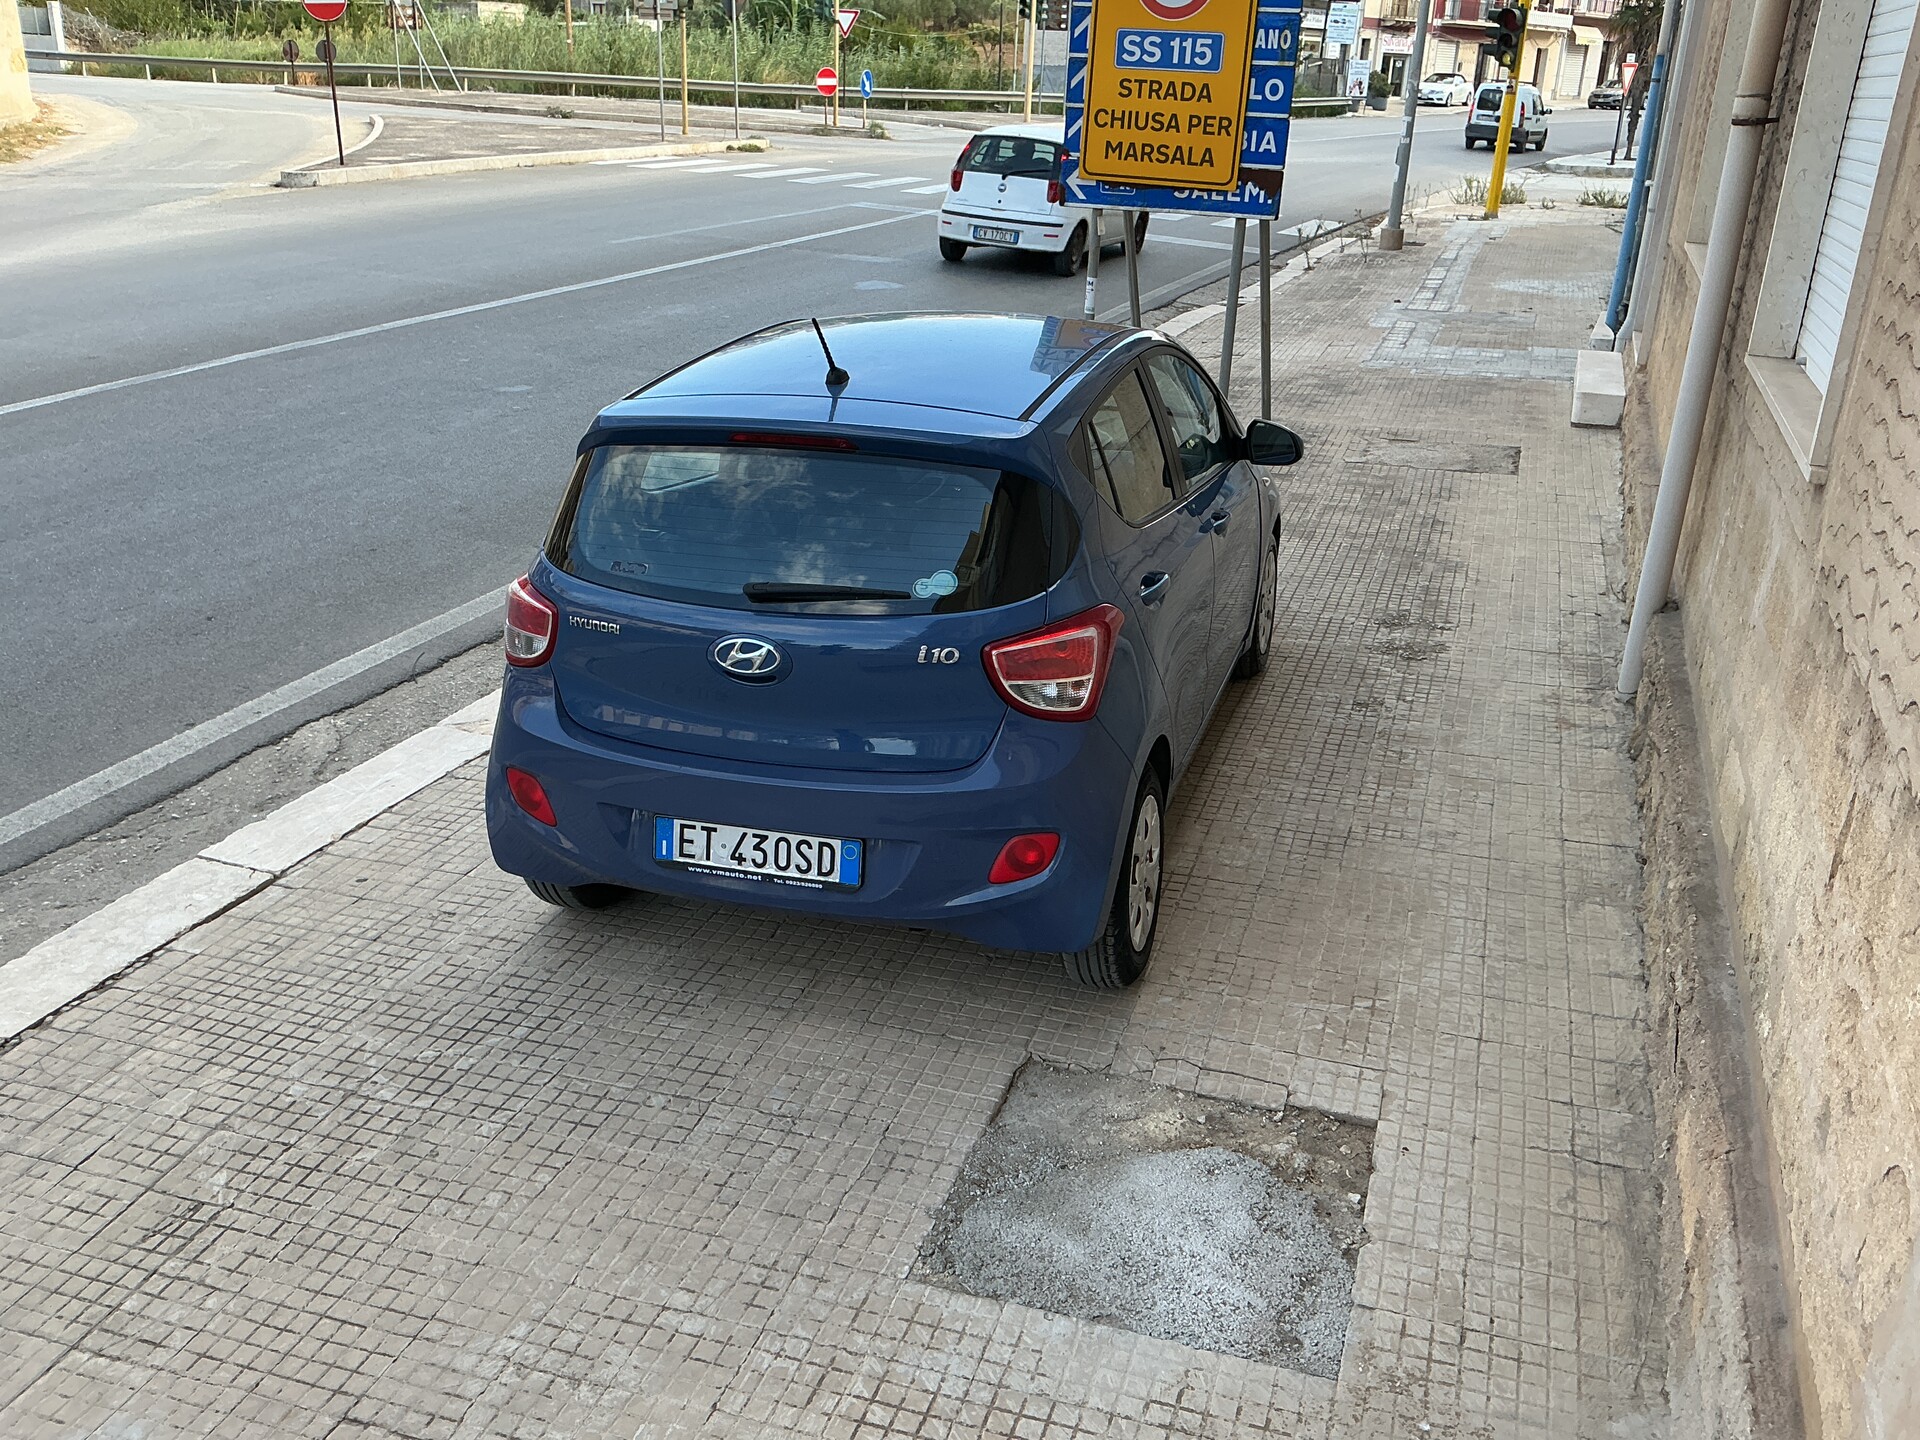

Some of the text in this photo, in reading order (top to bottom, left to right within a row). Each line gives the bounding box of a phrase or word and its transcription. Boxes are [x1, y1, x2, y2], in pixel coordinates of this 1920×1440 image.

[1121, 35, 1213, 66] SS 115
[1118, 78, 1213, 103] STRADA
[1093, 108, 1233, 137] CHIUSA PER
[1104, 140, 1215, 168] MARSALA
[569, 615, 620, 635] HYUNDAI
[917, 645, 960, 664] i10
[678, 823, 836, 878] ET 430SD
